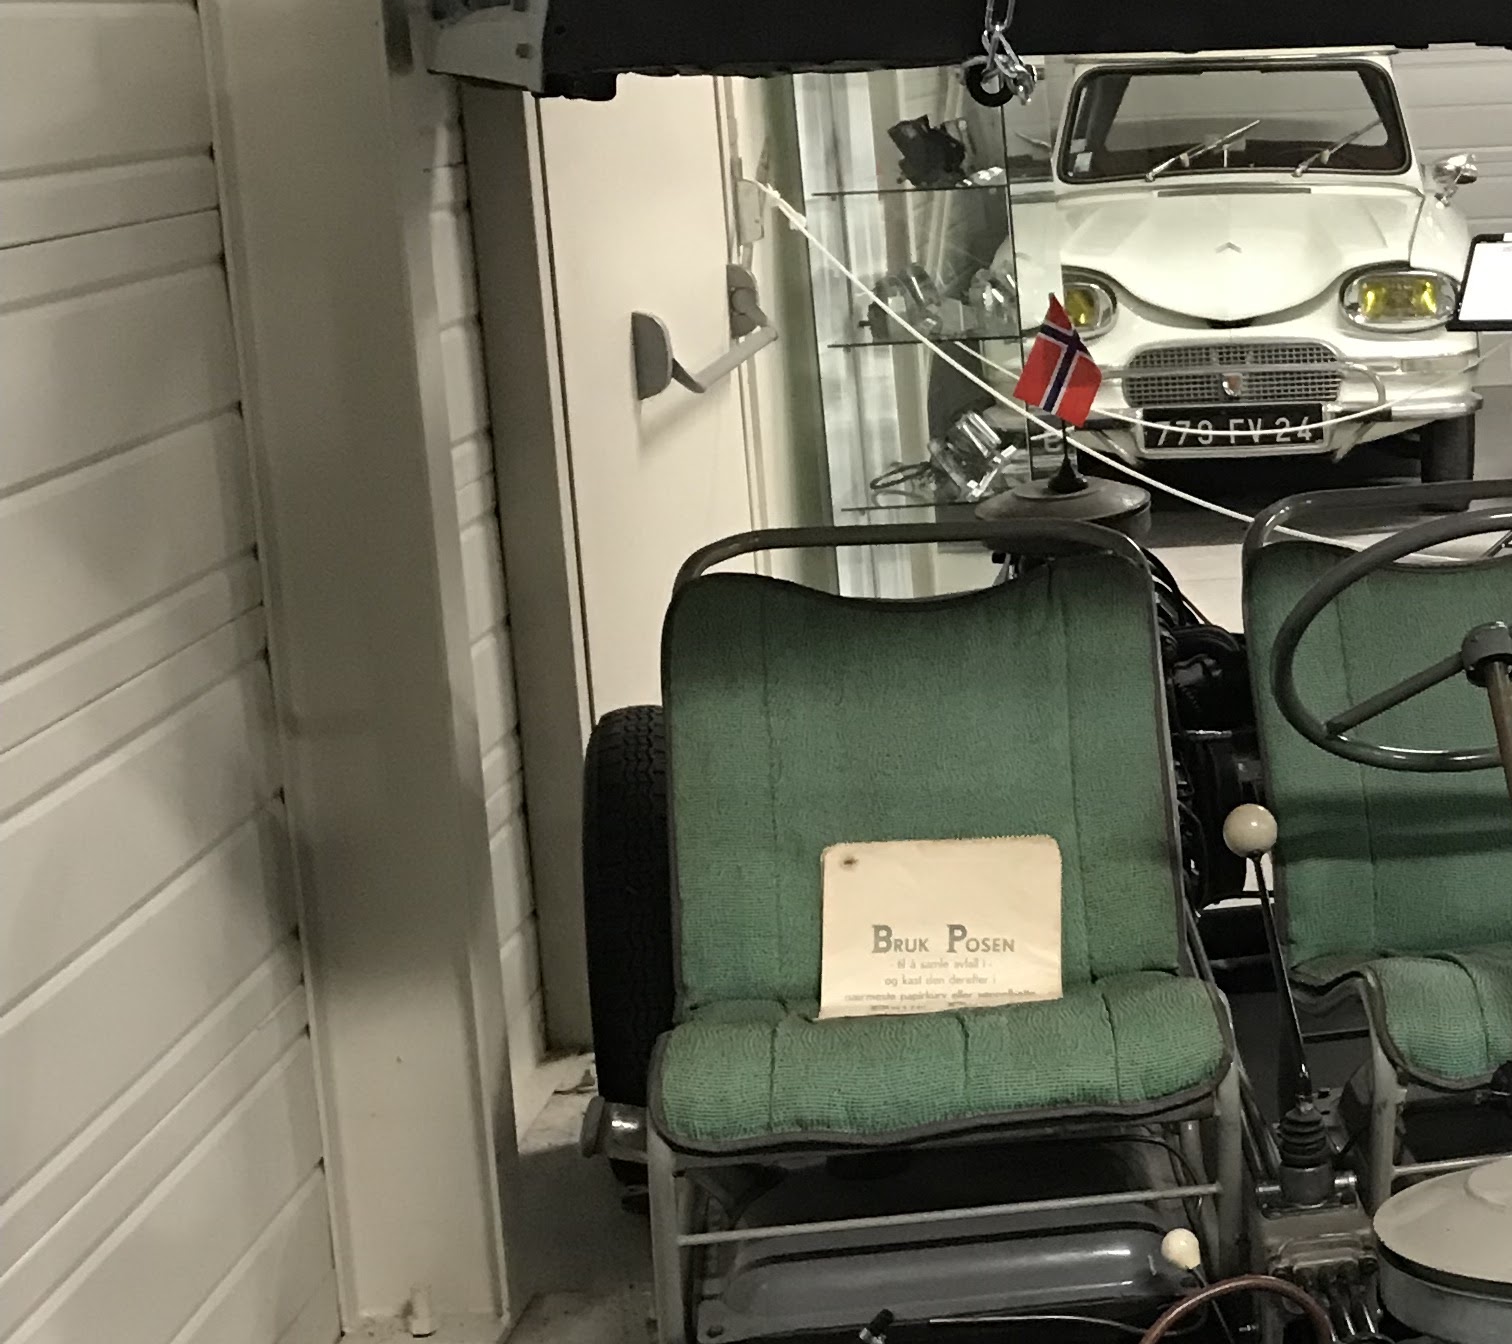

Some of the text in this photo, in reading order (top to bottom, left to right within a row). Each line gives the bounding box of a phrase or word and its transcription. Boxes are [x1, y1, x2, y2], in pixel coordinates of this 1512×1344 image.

[1156, 416, 1312, 446] 779 FV 24
